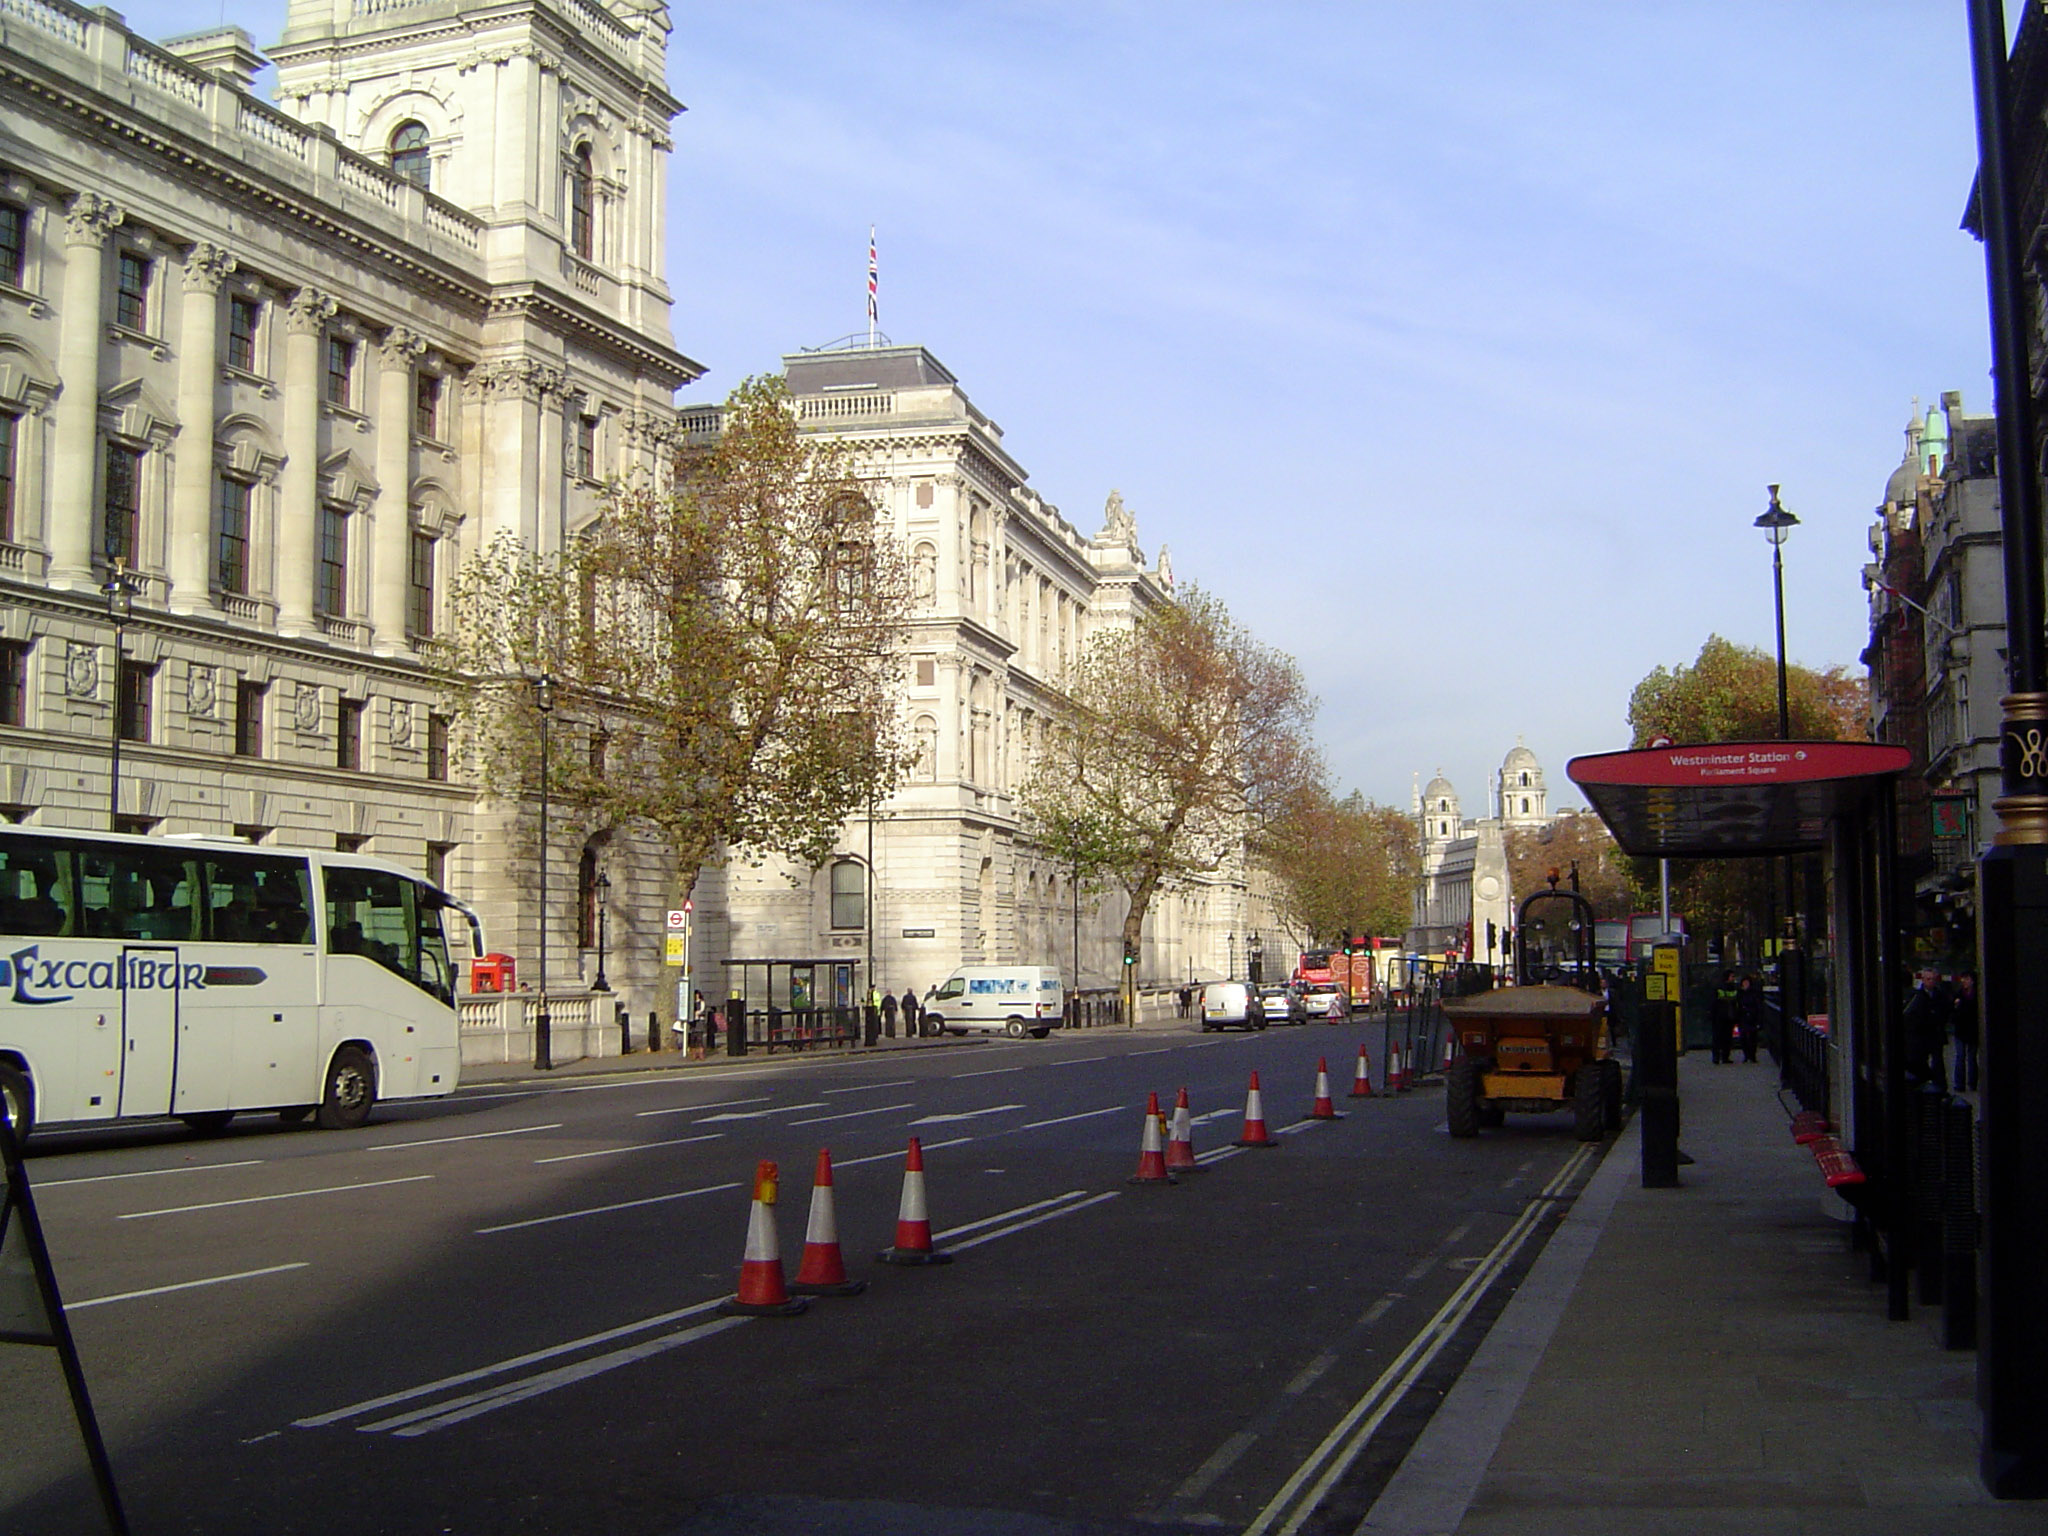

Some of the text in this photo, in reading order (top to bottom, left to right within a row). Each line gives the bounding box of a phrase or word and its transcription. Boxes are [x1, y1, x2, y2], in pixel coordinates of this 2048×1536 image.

[1670, 752, 1790, 766] Westminster Station
[1700, 766, 1776, 776] Parliament Square
